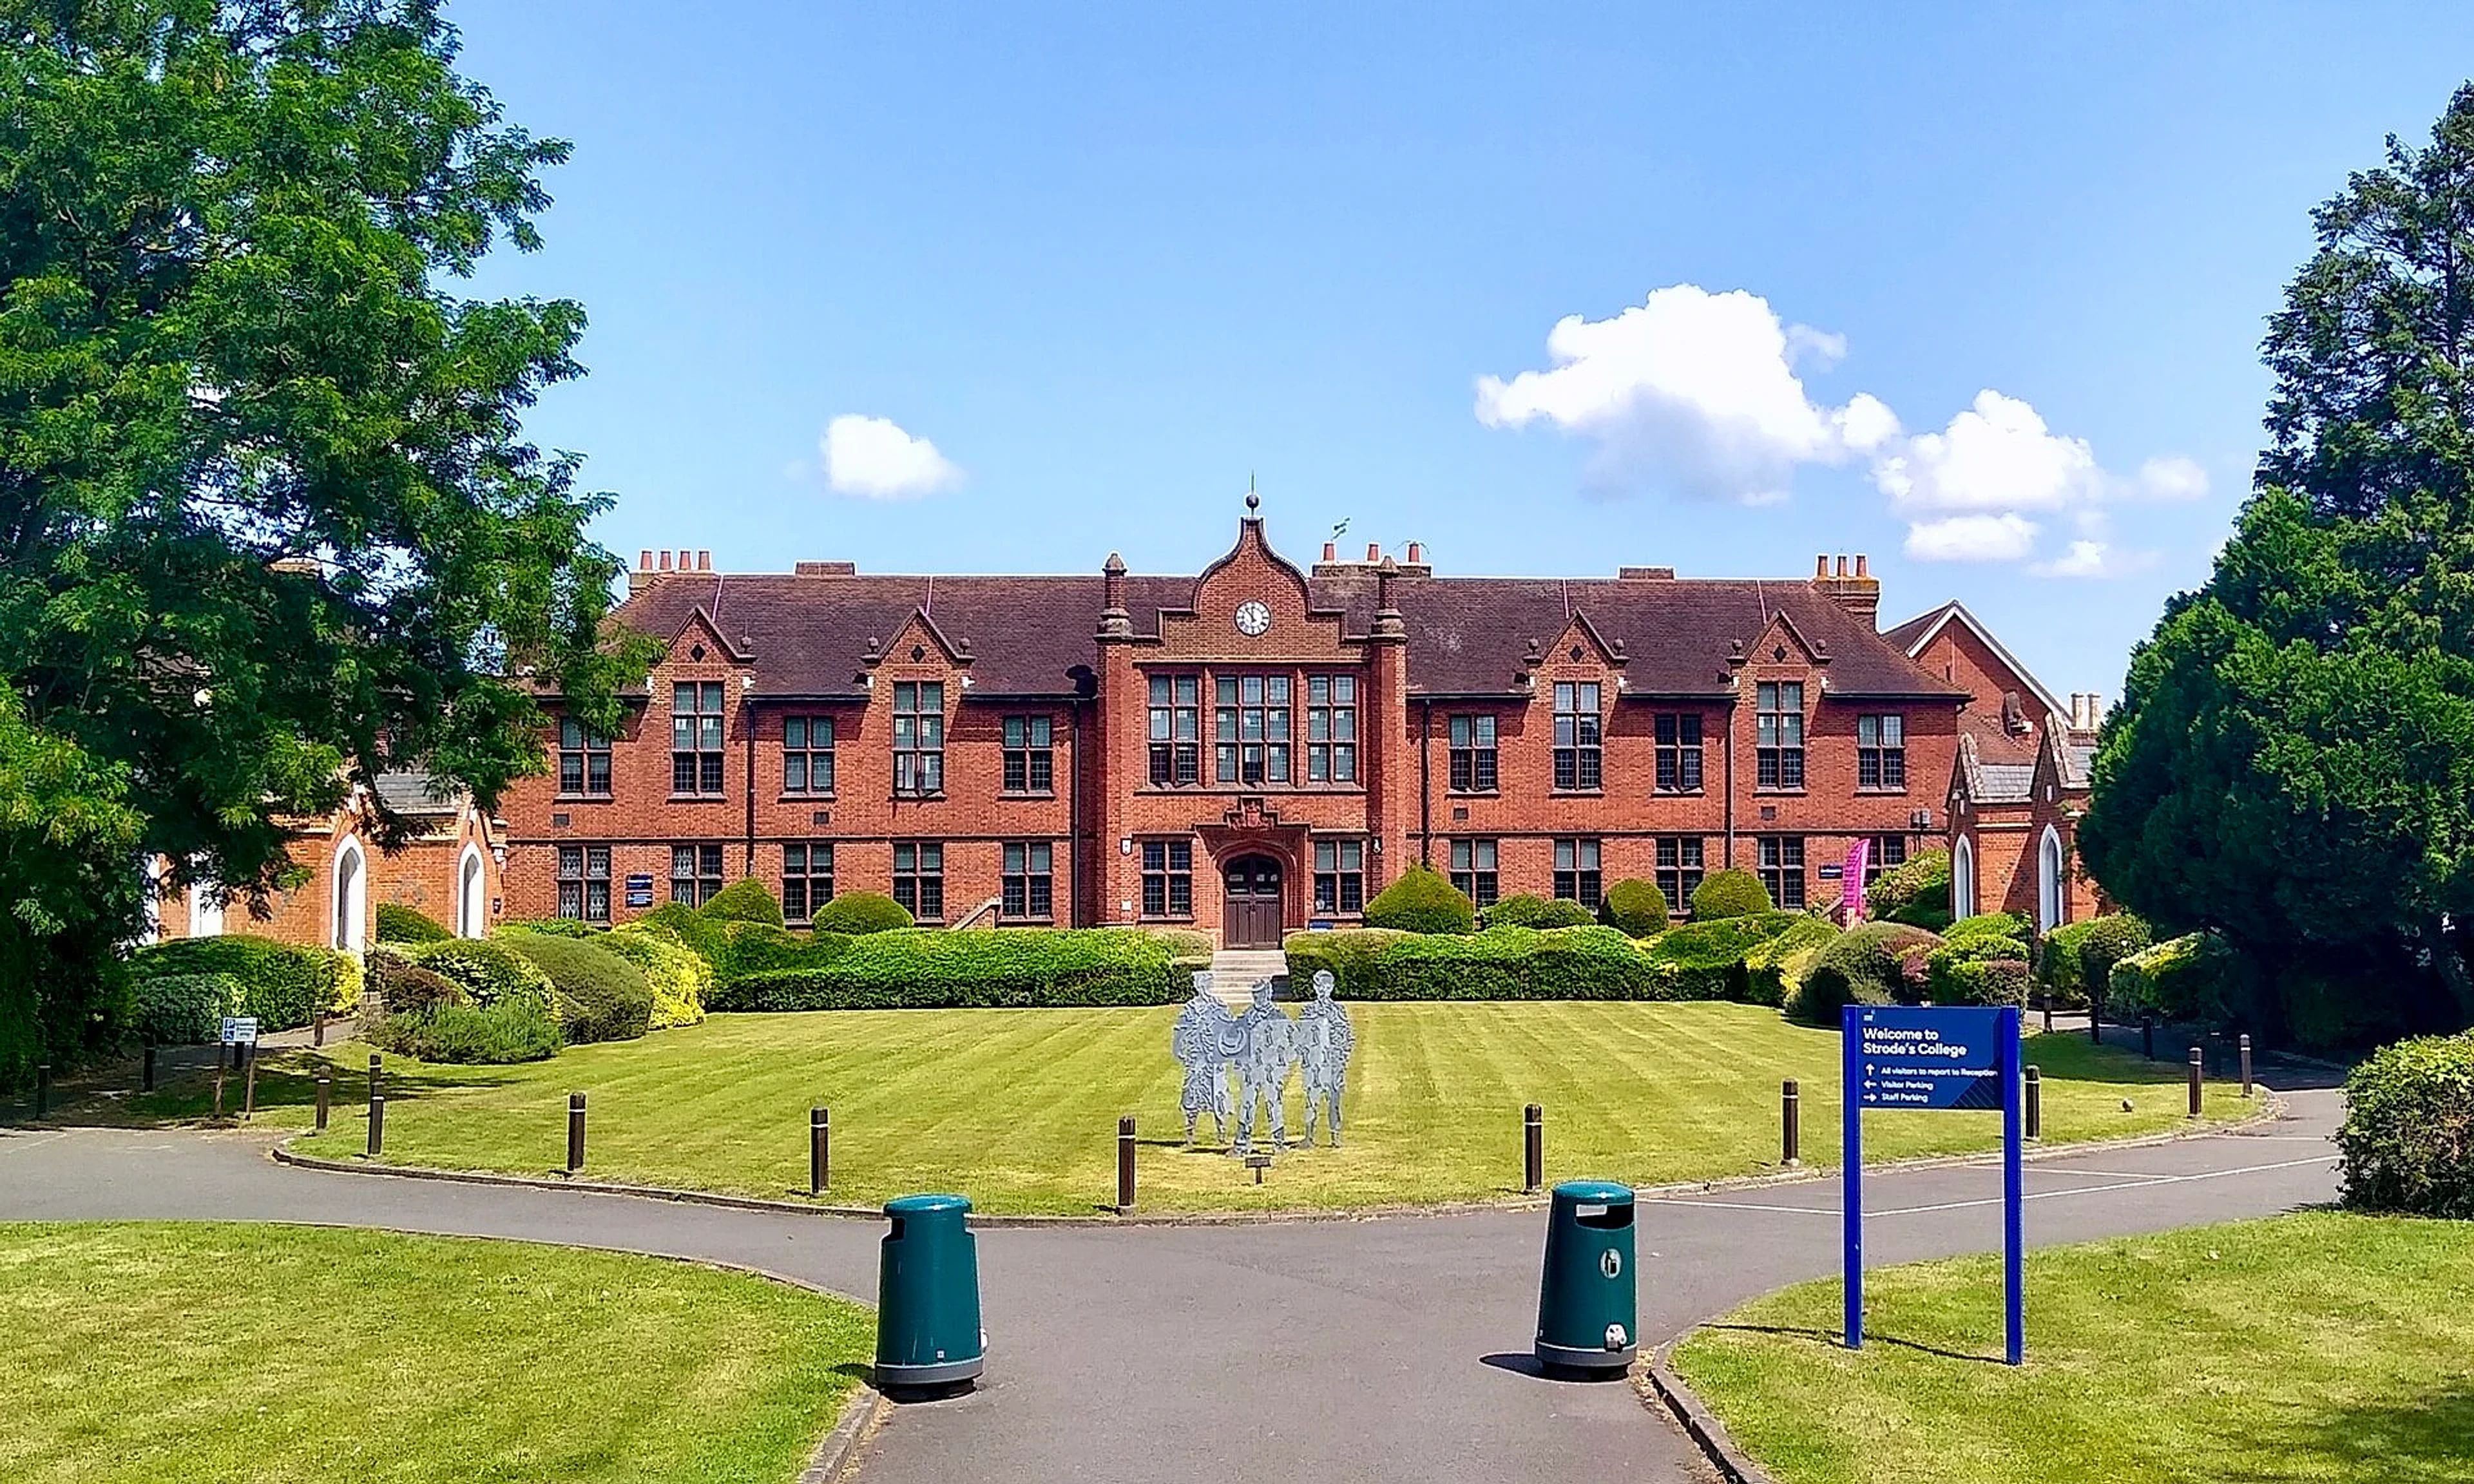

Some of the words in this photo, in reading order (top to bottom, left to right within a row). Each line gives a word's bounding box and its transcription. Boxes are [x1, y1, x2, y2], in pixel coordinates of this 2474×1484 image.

[1863, 1027, 1923, 1040] Welcome
[1924, 1029, 1939, 1040] to
[1863, 1042, 1916, 1055] Strode's
[1917, 1042, 1967, 1058] College
[1892, 1067, 1917, 1075] visitors
[1928, 1068, 1951, 1077] report
[1961, 1068, 1998, 1078] Reception
[1881, 1080, 1904, 1089] Visitor
[1906, 1080, 1933, 1090] Parking
[1881, 1092, 1899, 1101] Staff
[1901, 1092, 1928, 1103] Parking
